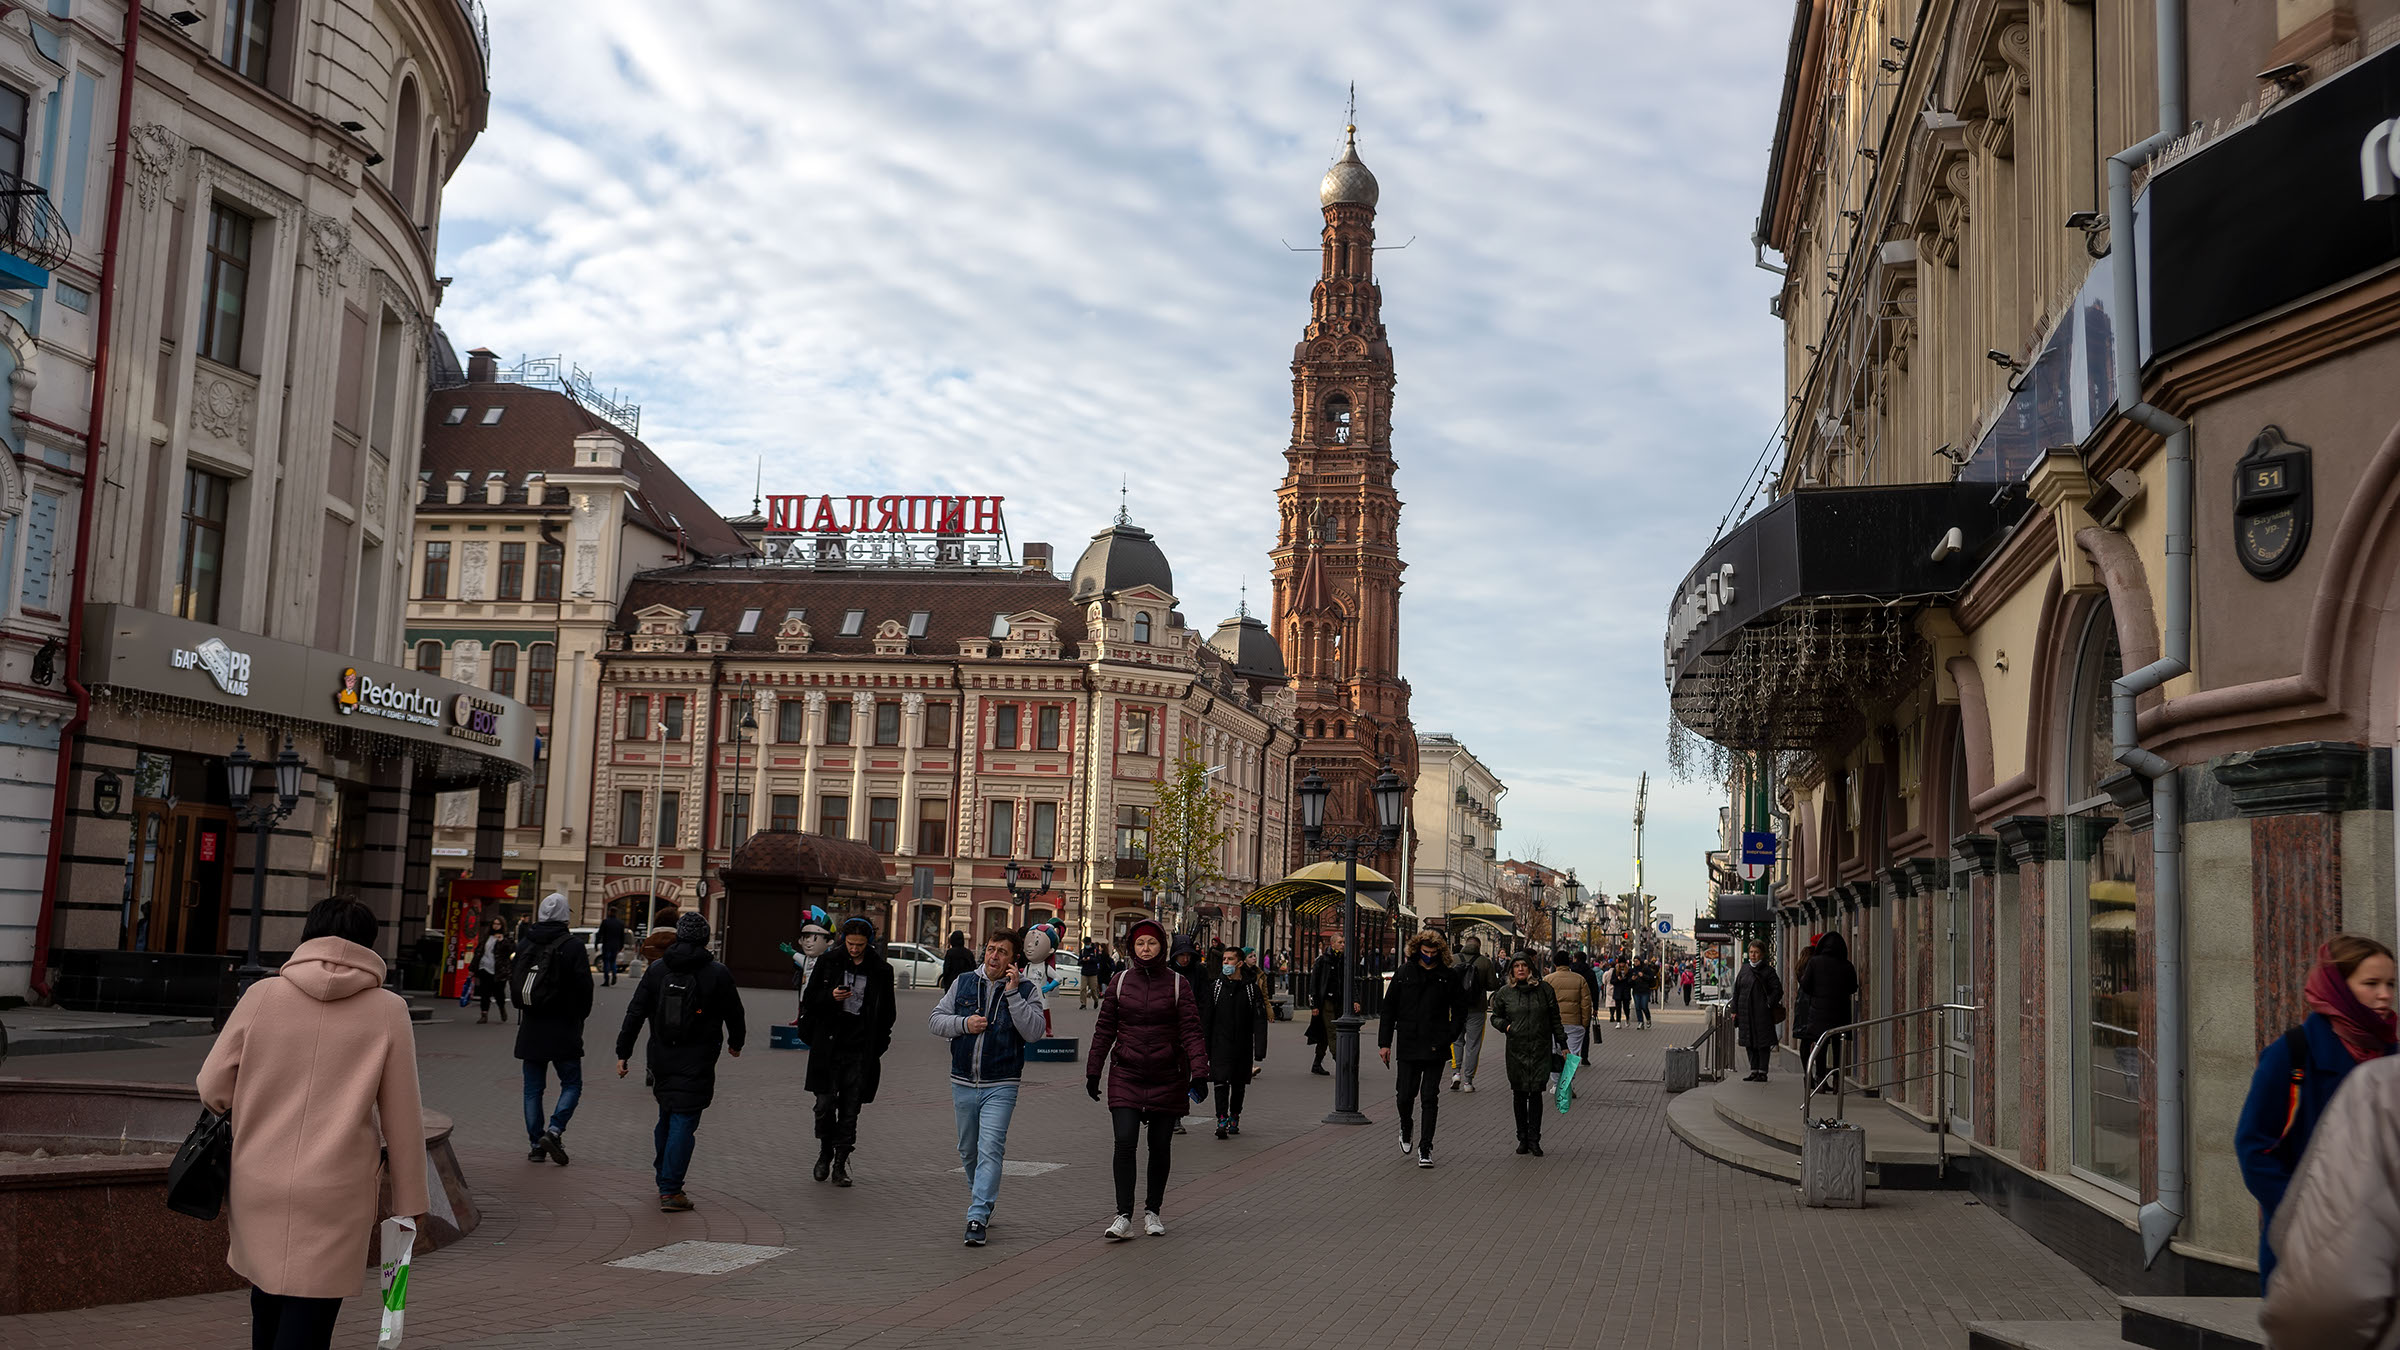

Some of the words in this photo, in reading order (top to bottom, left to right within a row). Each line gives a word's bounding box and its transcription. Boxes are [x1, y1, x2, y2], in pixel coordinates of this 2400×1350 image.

[2257, 470, 2279, 487] 51
[763, 494, 1005, 534] ШАЛЯПИН
[765, 542, 884, 560] PALACE
[901, 543, 1002, 562] HOTEL
[172, 648, 199, 670] БАР
[360, 676, 442, 717] Pedant.ru
[473, 710, 499, 735] BOX
